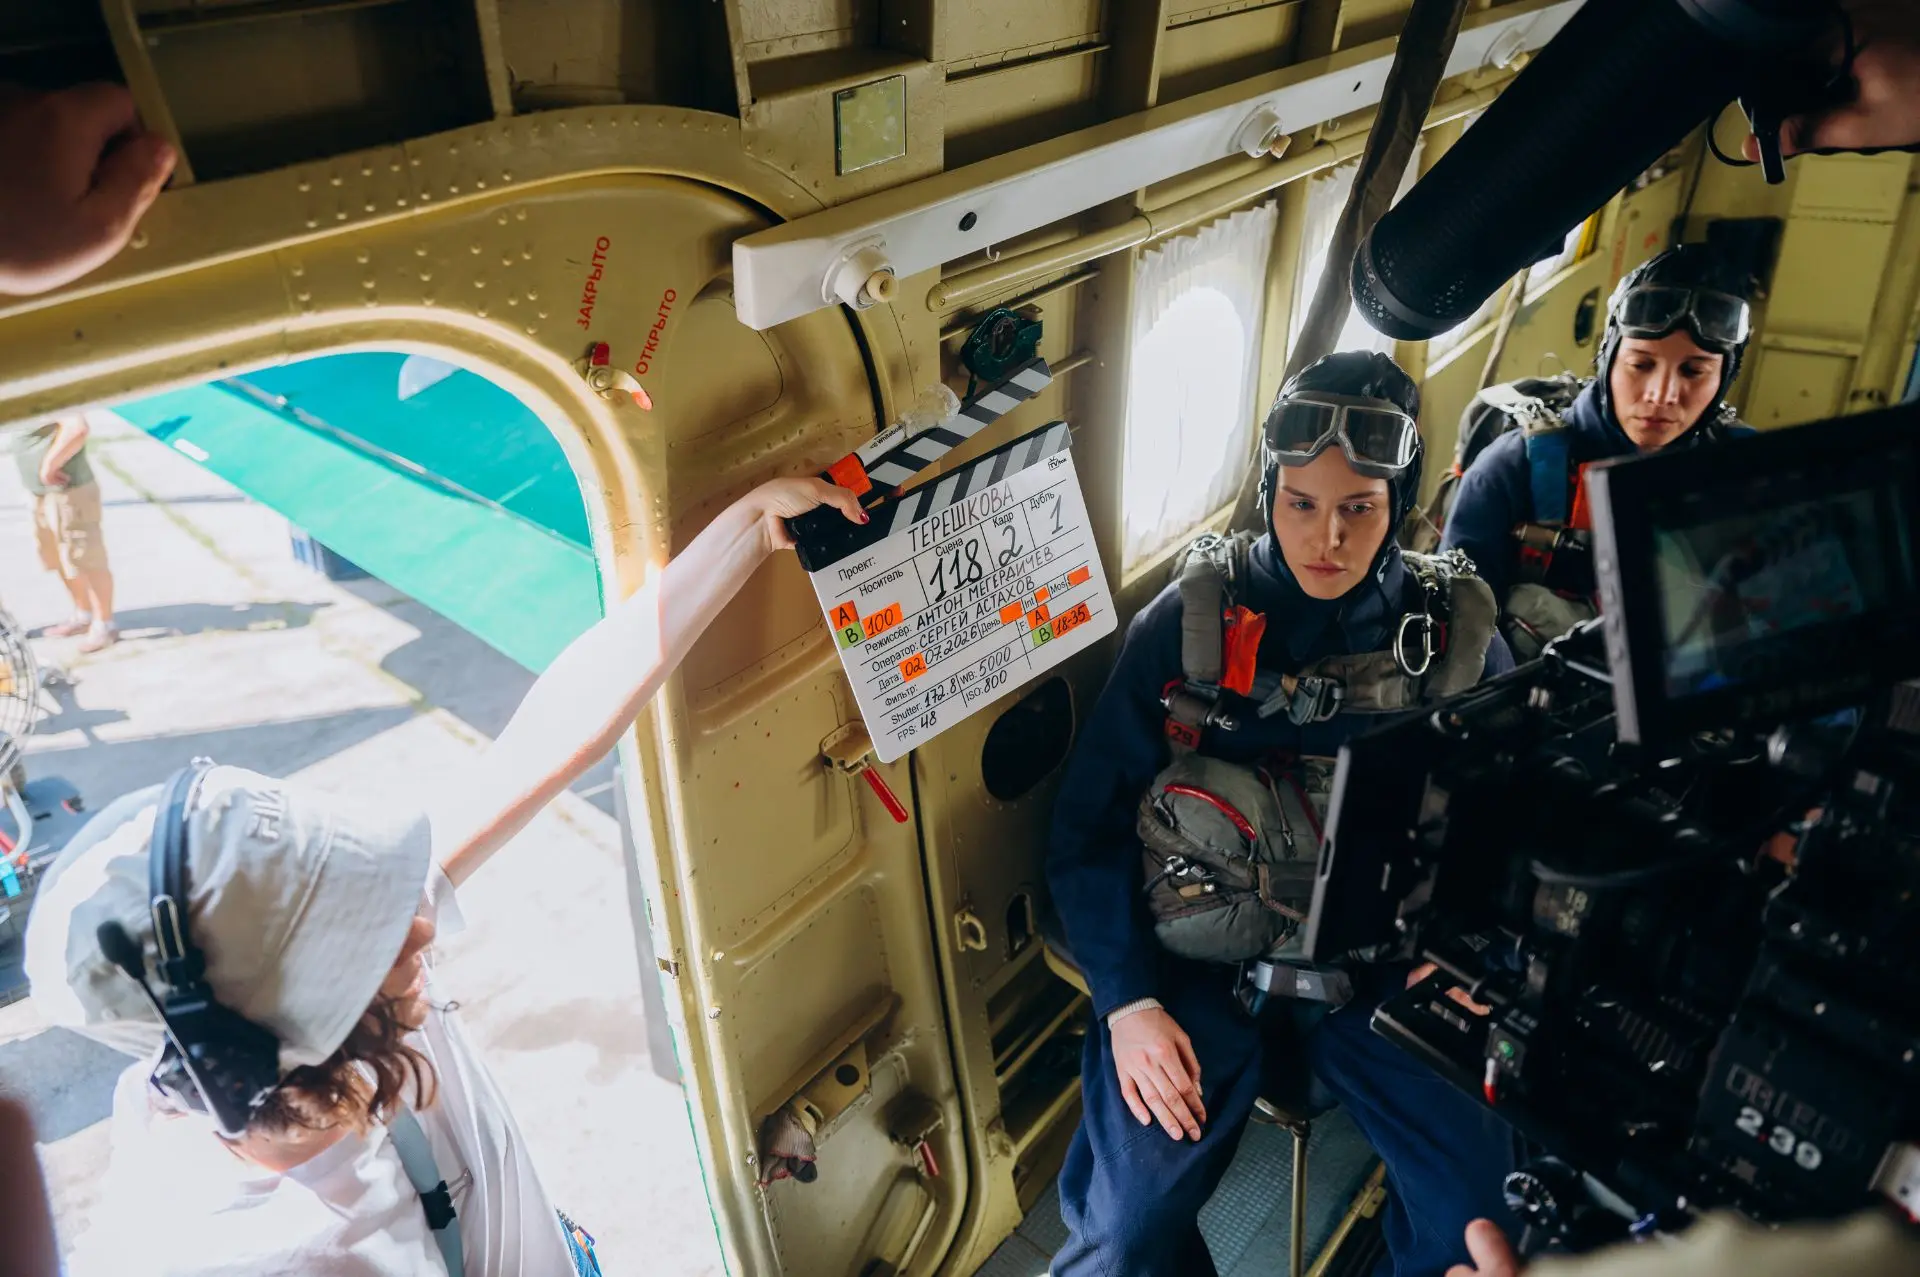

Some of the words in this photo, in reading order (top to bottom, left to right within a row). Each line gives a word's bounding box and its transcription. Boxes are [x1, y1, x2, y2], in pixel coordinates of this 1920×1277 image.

[577, 236, 610, 331] ЗАКРЫТО
[635, 288, 677, 375] ОТКРЫТО
[907, 481, 1014, 553] ТЕРЕШКОВА
[993, 511, 1014, 529] Кадр
[1029, 492, 1055, 511] Дубль
[1049, 494, 1064, 535] 1
[935, 537, 964, 558] Сцена
[998, 524, 1024, 568] 2
[838, 556, 877, 581] Проект:
[859, 568, 904, 597] Носитель
[929, 538, 983, 602] 118
[864, 623, 913, 655] Режиссёр:
[916, 593, 963, 631] АНТОН
[968, 546, 1054, 602] МЕГЕРДИЧЕВ
[1055, 602, 1087, 636] 18-35
[867, 608, 894, 637] 100
[871, 641, 919, 672] Оператор:
[919, 610, 969, 649] СЕРГЕЙ
[976, 575, 1035, 619] АСТАХОВ
[878, 672, 902, 692] Дата:
[980, 619, 1001, 636] День
[959, 669, 978, 685] WB:
[978, 646, 1011, 678] 5000
[884, 683, 918, 708] Фильтр:
[890, 702, 923, 725] Shutter:
[924, 677, 957, 709] 172.8
[965, 686, 985, 702] ISO:
[984, 669, 1008, 694] 800
[897, 723, 918, 741] FPS:
[920, 710, 937, 729] 48
[1734, 1106, 1823, 1170] 2.39
